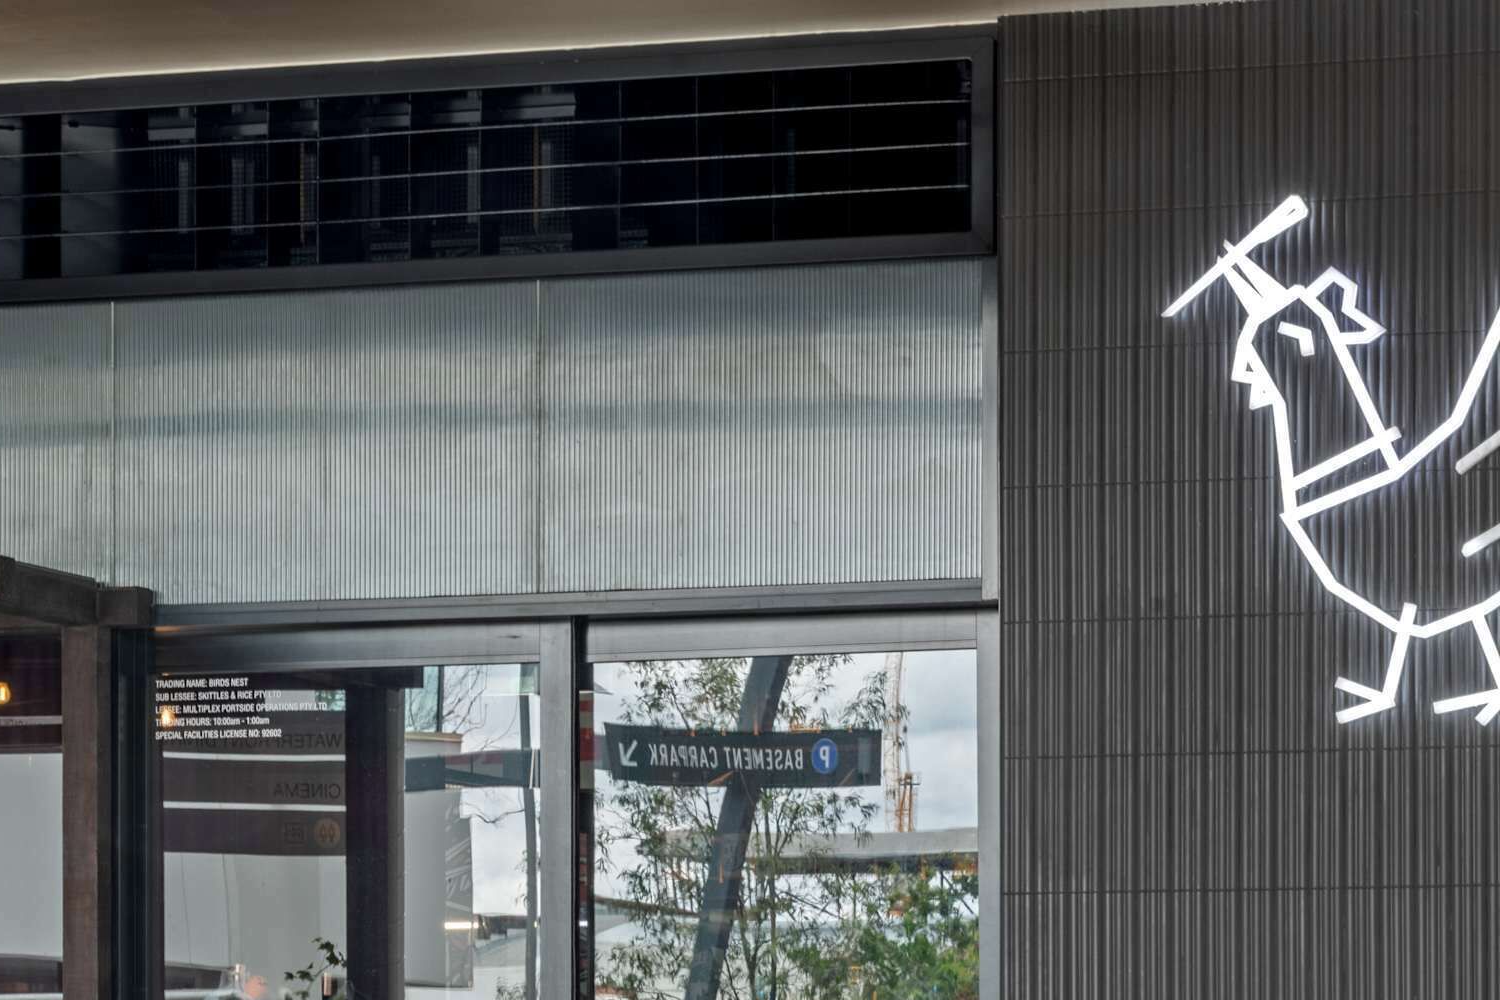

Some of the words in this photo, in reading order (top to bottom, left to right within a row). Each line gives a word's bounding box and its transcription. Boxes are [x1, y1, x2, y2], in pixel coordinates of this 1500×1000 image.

[156, 679, 185, 689] TRADING
[186, 678, 208, 688] NAME:
[208, 677, 229, 688] BIRDS
[230, 677, 249, 687] NEST
[155, 691, 170, 702] SUB
[170, 691, 197, 701] LESSEE:
[198, 690, 229, 700] SKITTLES
[230, 690, 236, 700] &
[236, 690, 253, 700] RICE
[253, 689, 266, 699] PTY
[267, 690, 282, 698] LTD
[182, 704, 220, 714] MULTIPLEX
[221, 703, 254, 712] PORTSIDE
[255, 702, 298, 712] OPERATIONS
[186, 717, 211, 727] HOURS:
[213, 716, 241, 726] 10:00am
[246, 716, 270, 725] 1:00am
[155, 730, 183, 740] SPECIAL
[183, 730, 219, 739] FACILITIES
[219, 729, 248, 738] LICENSE
[248, 729, 260, 738] NO:
[261, 728, 282, 738] 92602
